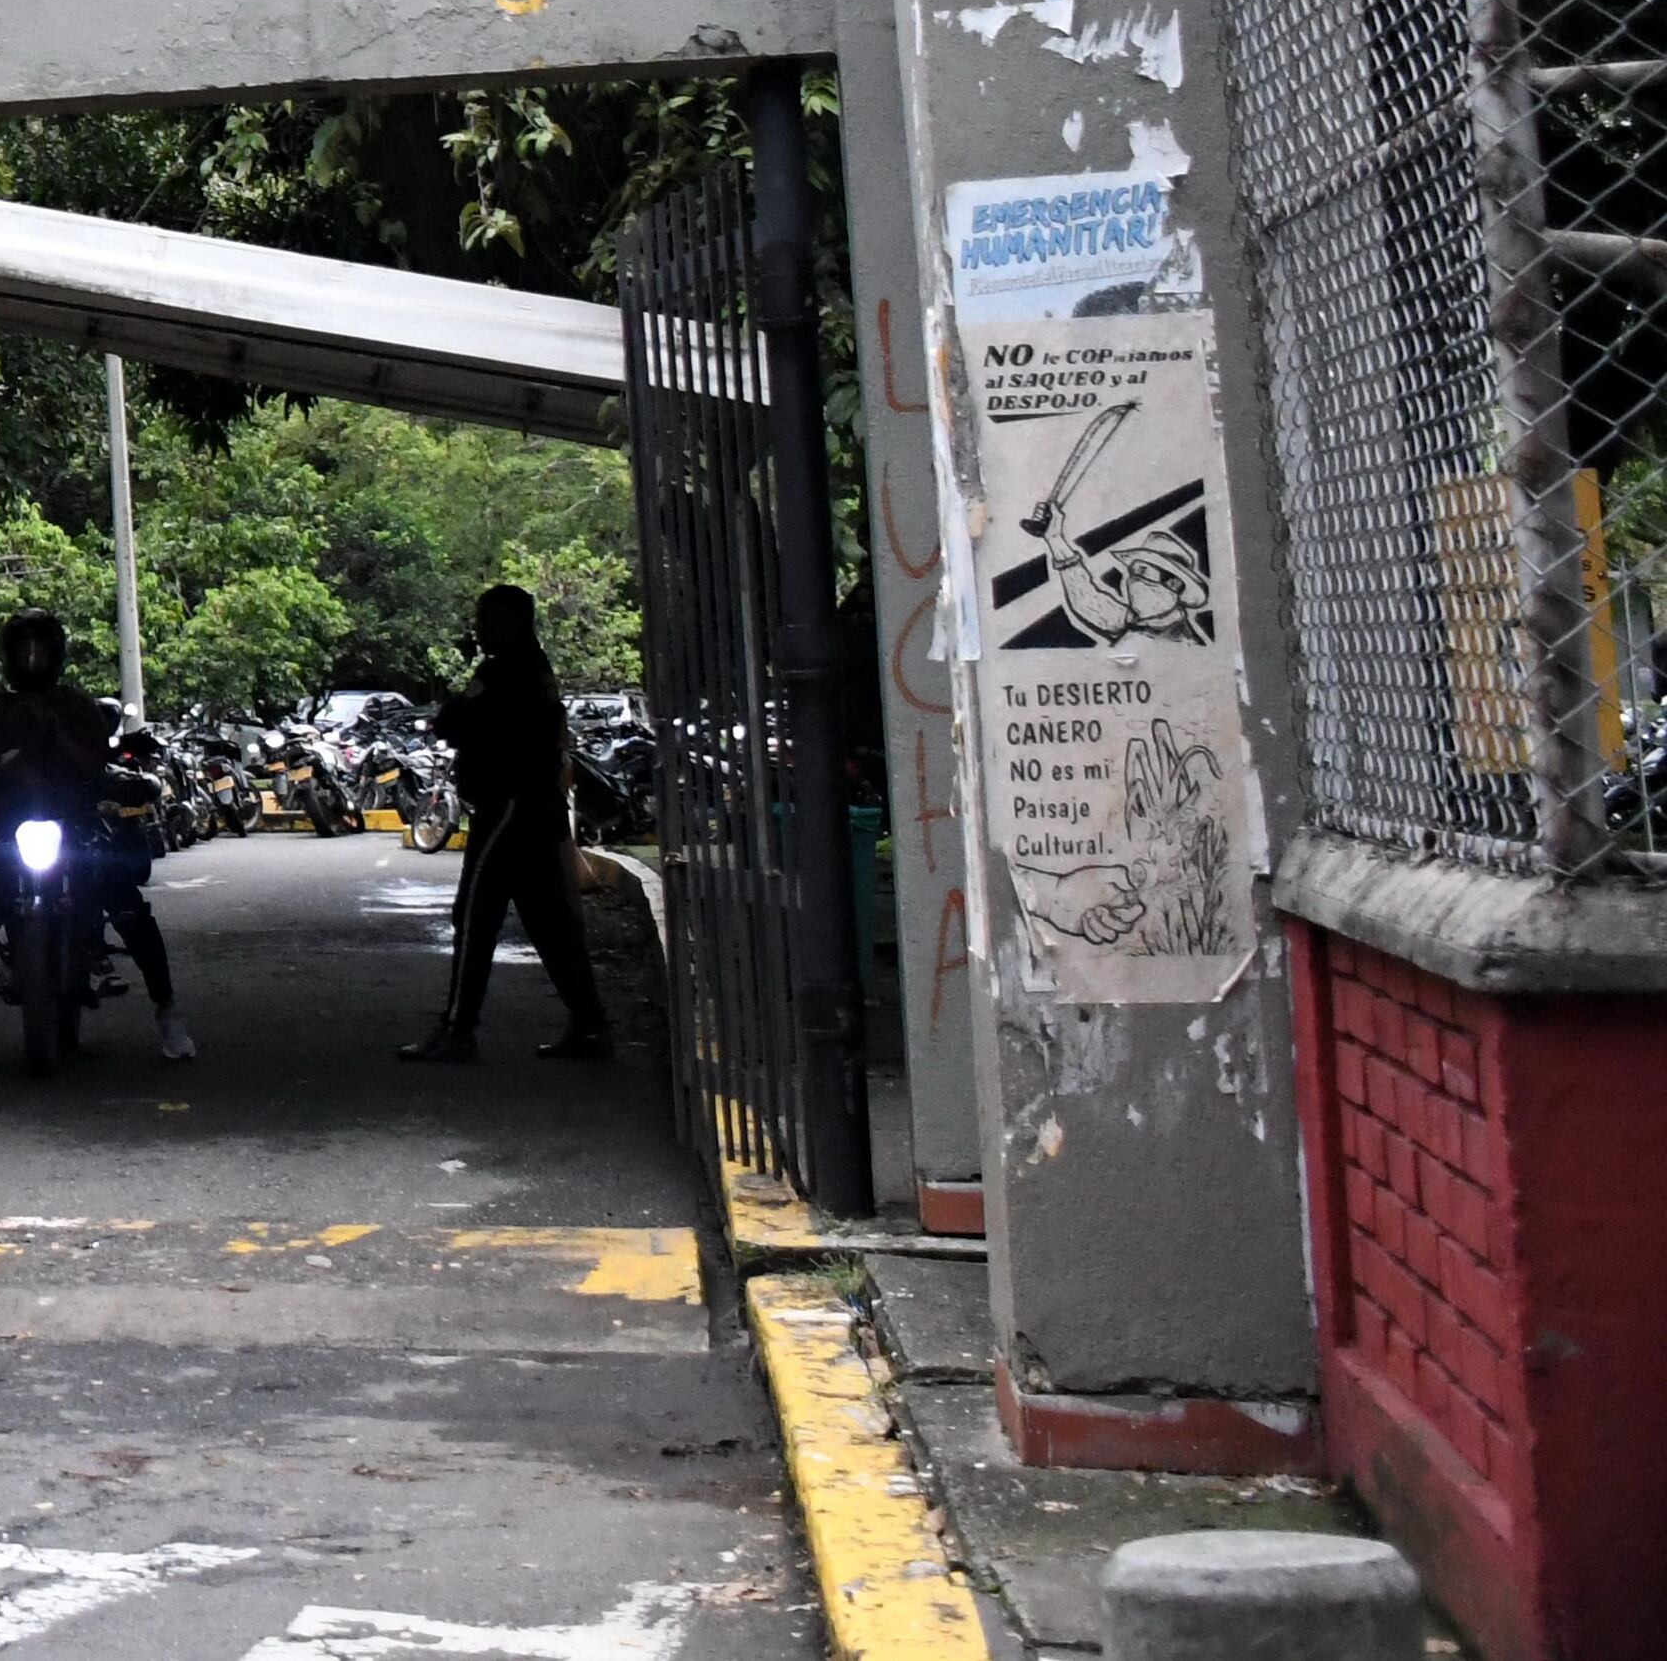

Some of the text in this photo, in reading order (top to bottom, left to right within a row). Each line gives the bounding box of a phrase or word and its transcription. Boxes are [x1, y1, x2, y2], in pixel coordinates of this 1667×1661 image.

[972, 181, 1162, 234] EMERGENCIA
[983, 343, 1034, 368] NO
[1043, 352, 1060, 365] le
[985, 370, 1148, 390] al SAQUEO y al
[986, 392, 1102, 411] DESPOJO.
[1002, 680, 1151, 707] Tu DESIERTO
[1006, 715, 1102, 746] CAÑERO
[1010, 758, 1110, 782] NO es mi
[1014, 796, 1090, 825] Paisaje
[1016, 832, 1113, 857] Cultural.
